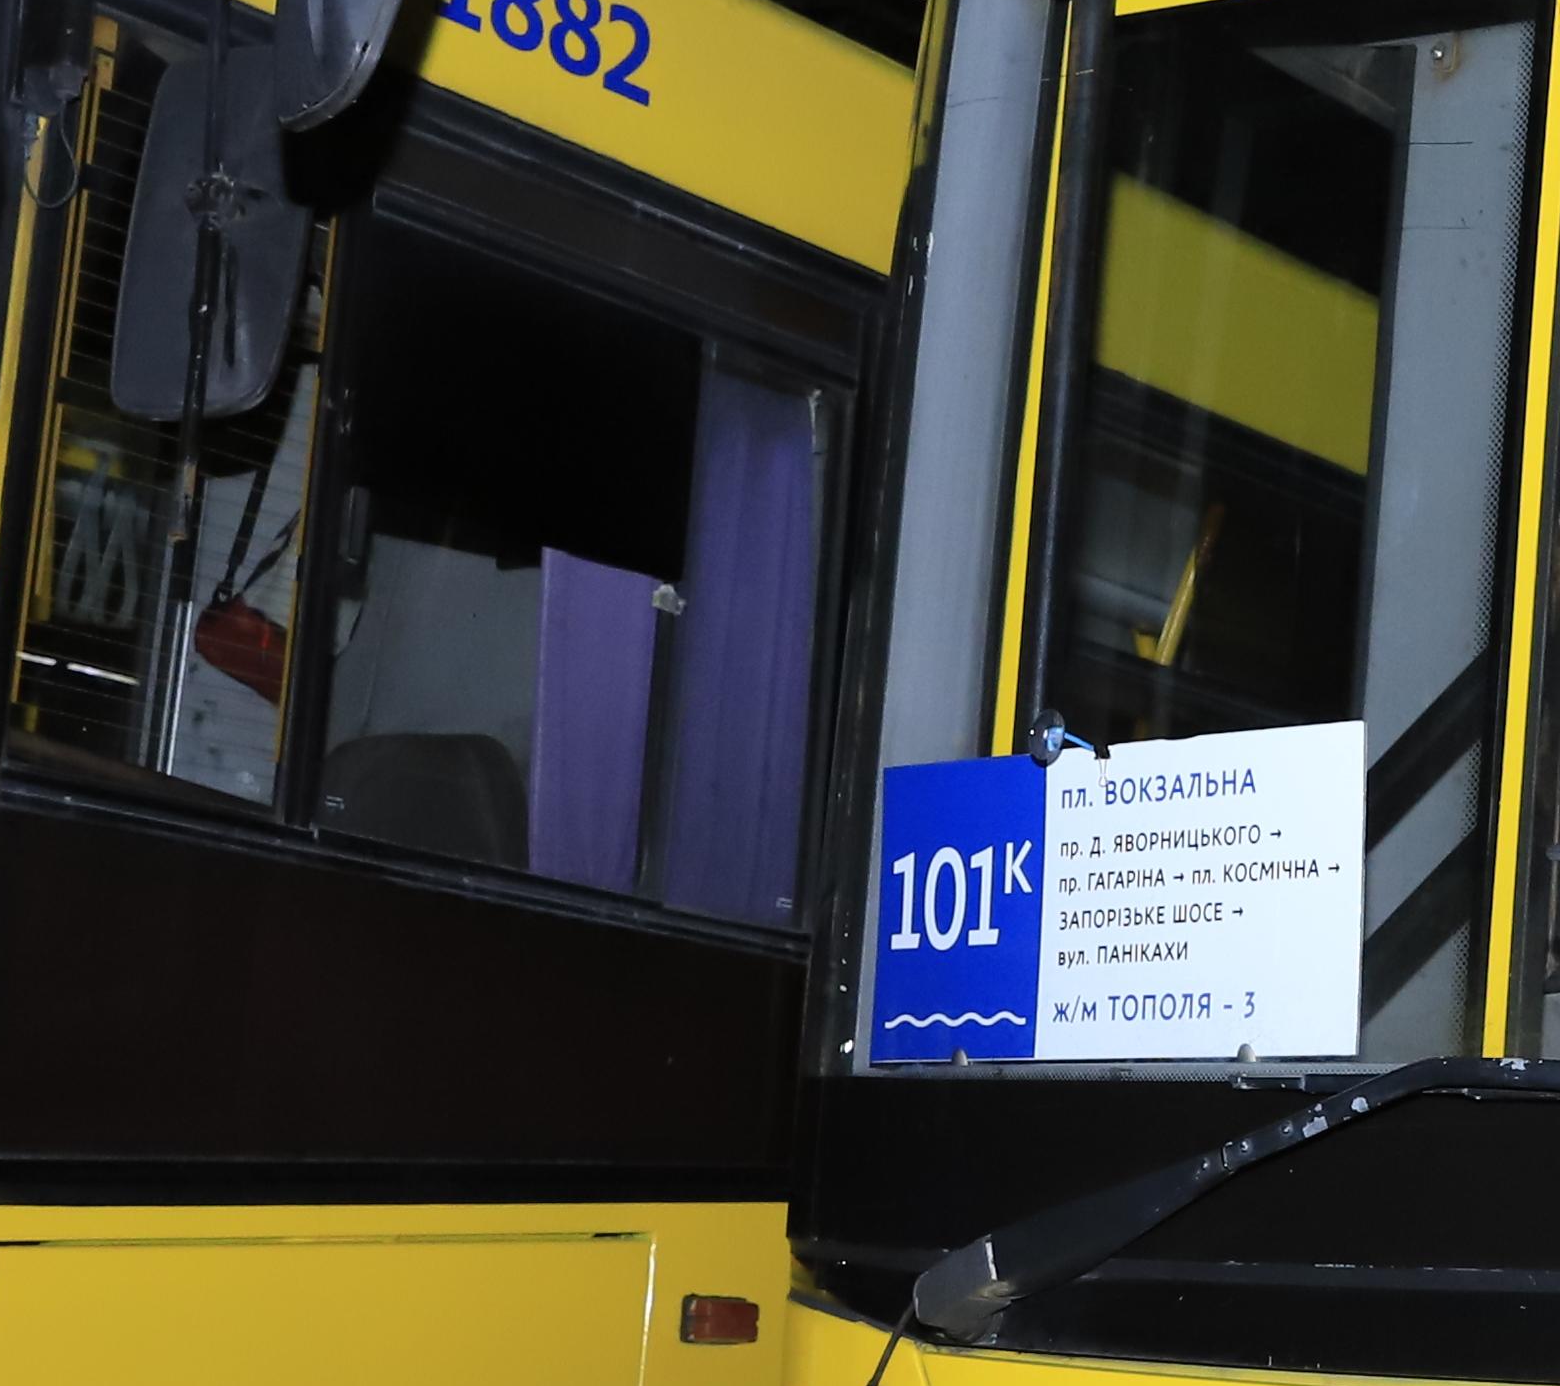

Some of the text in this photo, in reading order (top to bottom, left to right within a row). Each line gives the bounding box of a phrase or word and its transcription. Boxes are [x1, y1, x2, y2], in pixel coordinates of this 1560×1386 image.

[1061, 768, 1256, 809] пл. ВОКЗАЛЬНА
[1060, 824, 1261, 860] пр. Д. ЯВОРНИЦЬКОГО
[1059, 859, 1319, 896] пр. ГАГАРІНА пл. КОСМІЧНА
[1059, 902, 1223, 931] ЗАПОРІЗЬКЕ ШОСЕ
[1058, 941, 1189, 969] вул. ПАНІКАХИ
[1052, 995, 1097, 1023] ж/м
[1108, 992, 1212, 1022] ТОПОЛЯ
[1244, 991, 1256, 1019] 3
